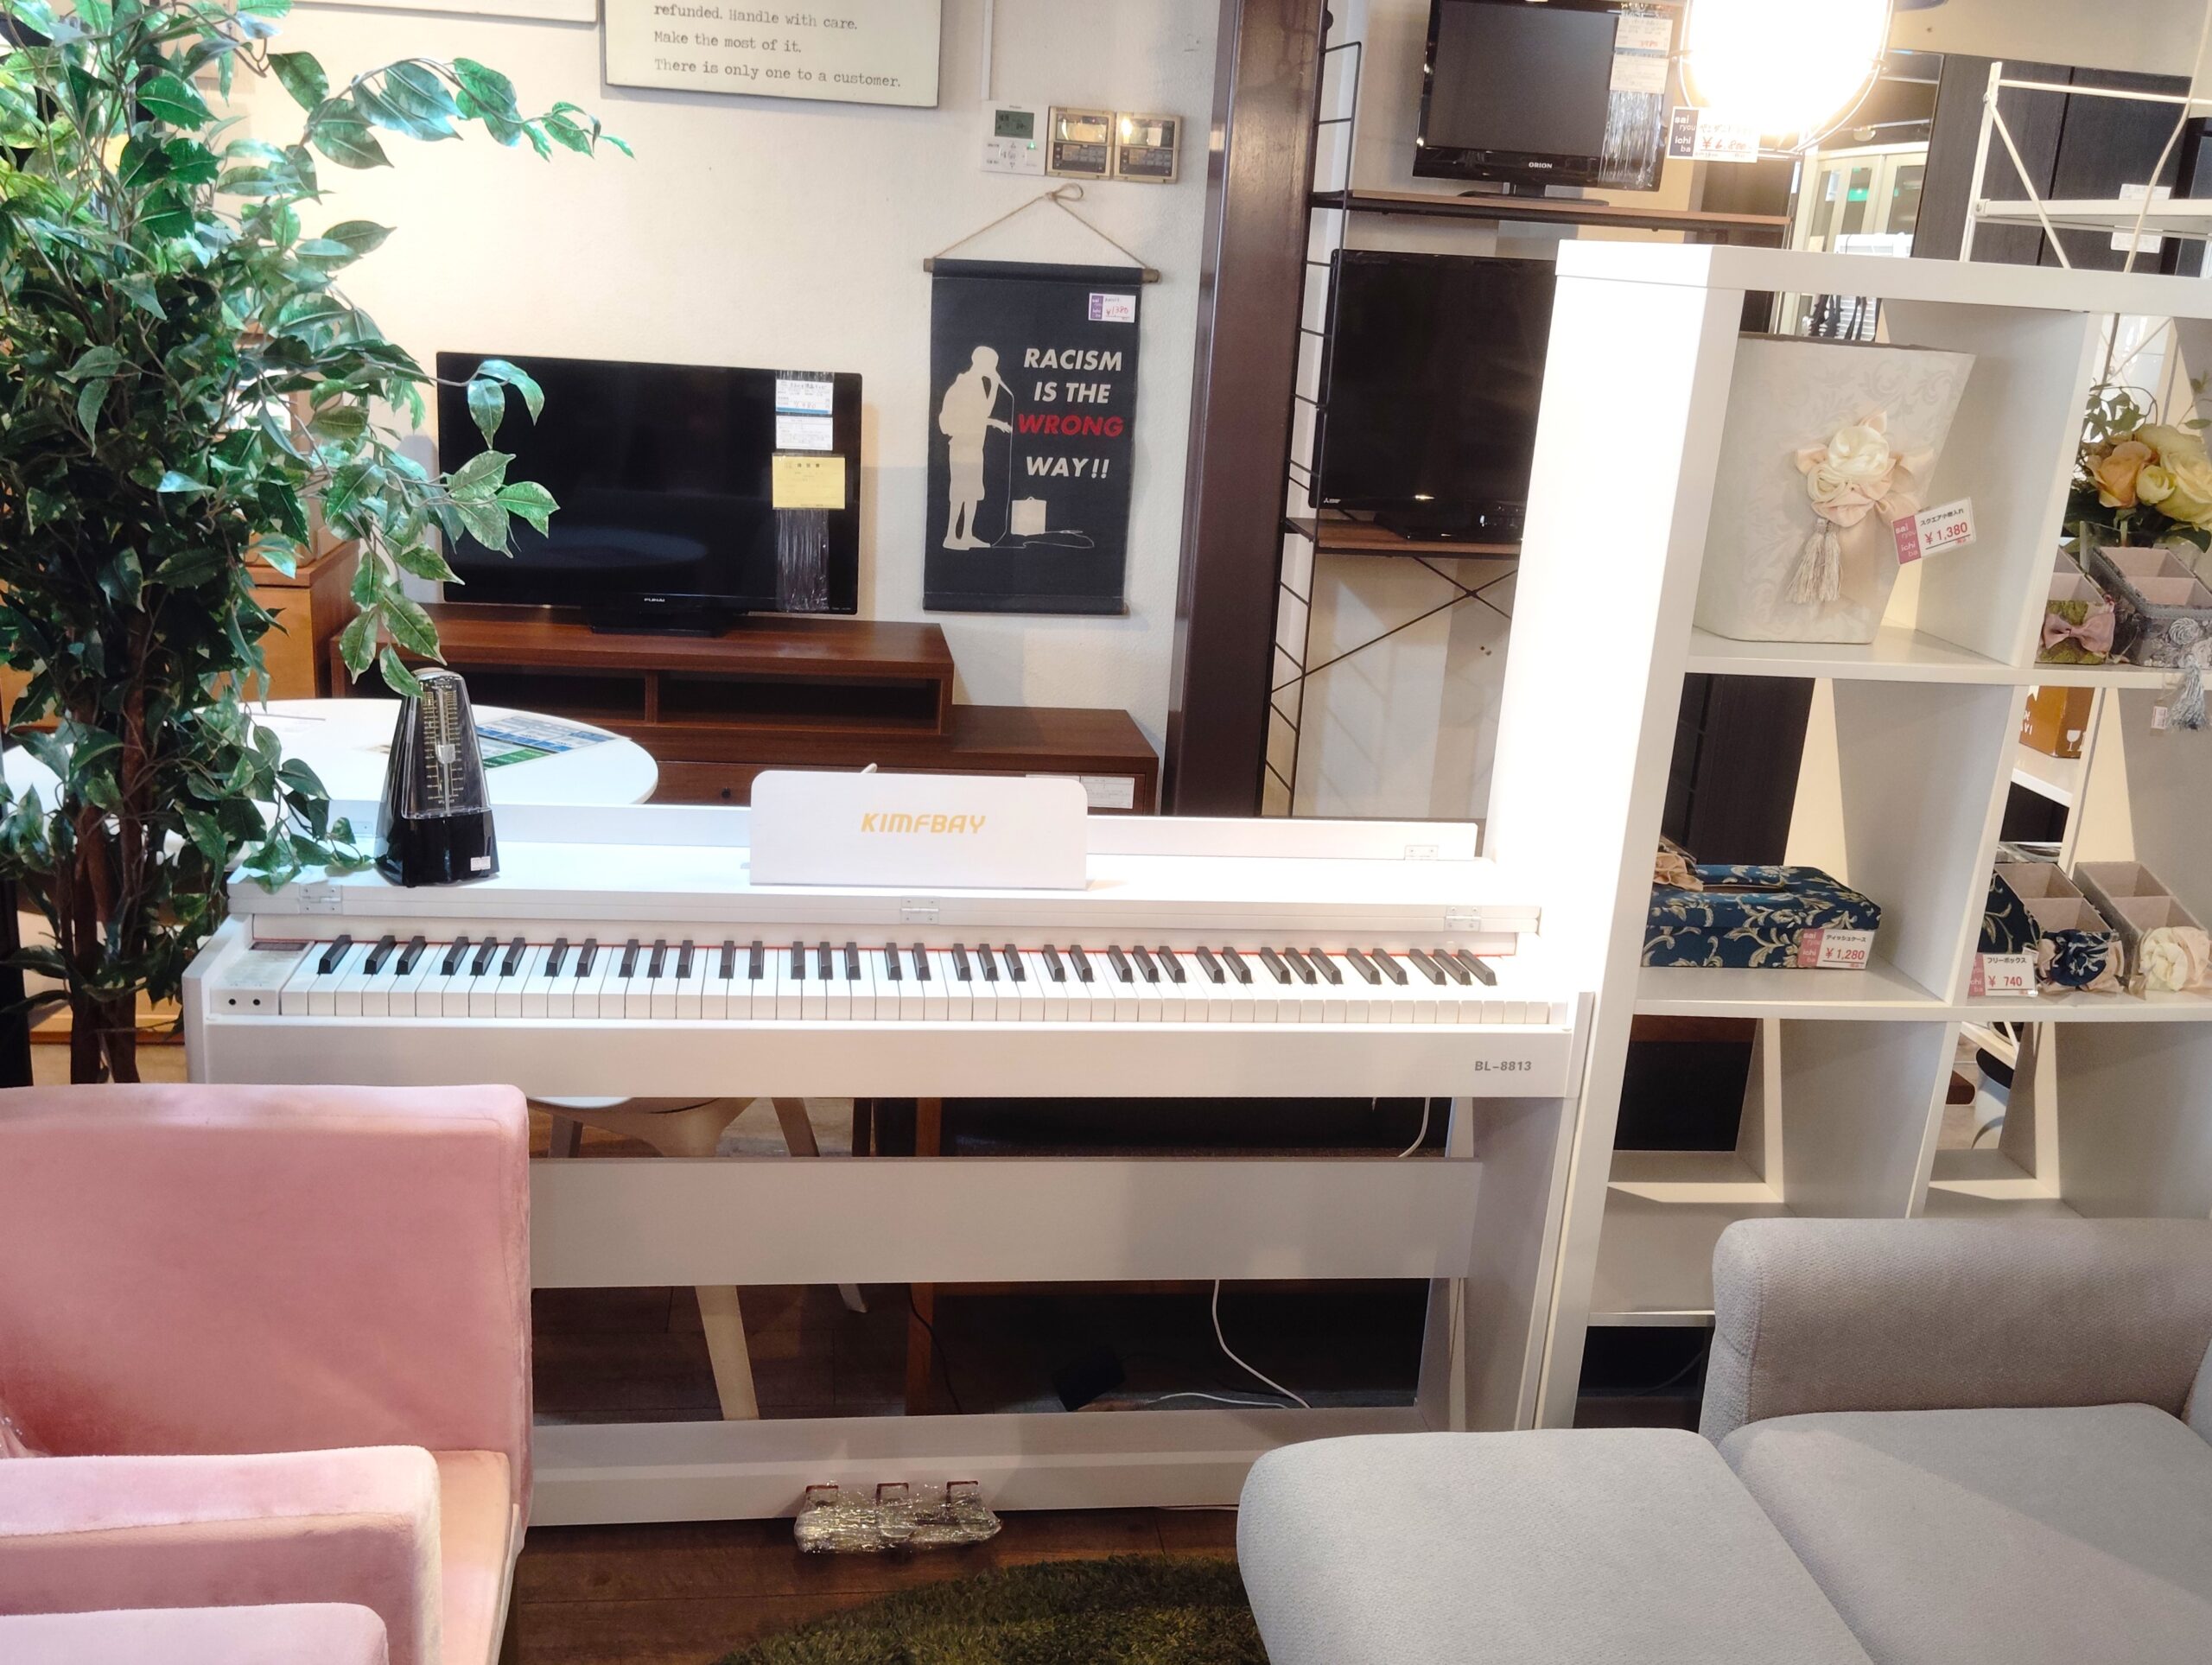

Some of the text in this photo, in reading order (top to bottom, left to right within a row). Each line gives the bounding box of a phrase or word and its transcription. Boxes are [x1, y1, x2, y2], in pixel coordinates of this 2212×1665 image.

[654, 3, 858, 30] refunded. Handle with care.
[654, 30, 802, 54] Make the most of it.
[654, 58, 901, 88] There is only one to a customer.
[1023, 347, 1122, 372] RACISM
[1033, 381, 1112, 404] IS THE
[1017, 414, 1123, 438] WRONG
[1026, 456, 1110, 480] WAY!!
[861, 812, 987, 835] KIMFBAY
[1474, 1060, 1532, 1071] BL-8813
